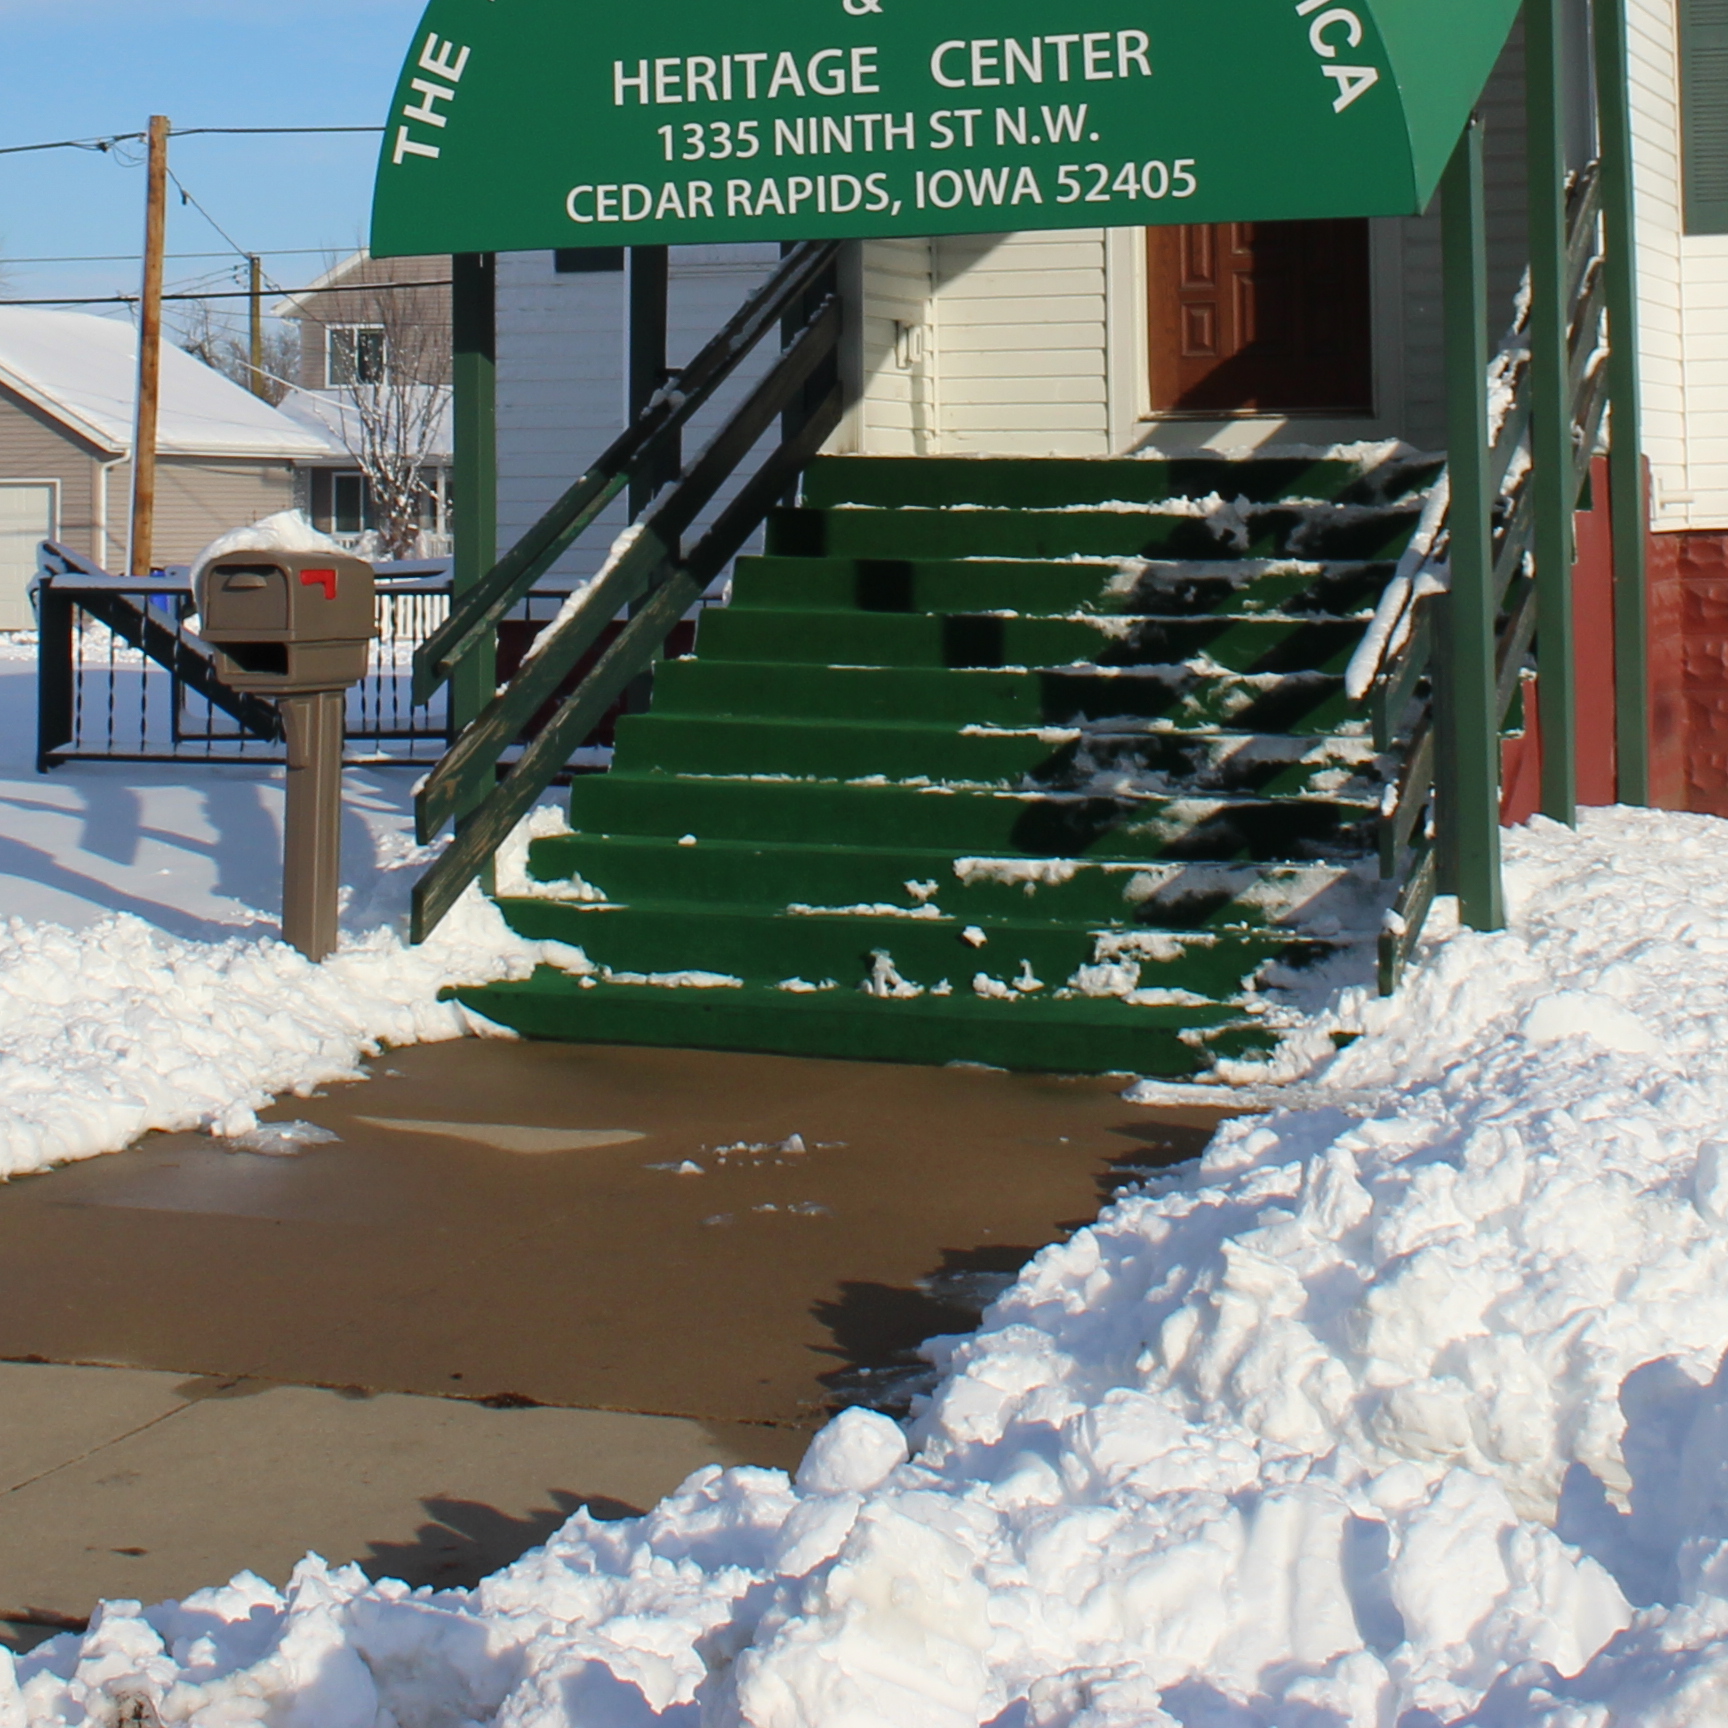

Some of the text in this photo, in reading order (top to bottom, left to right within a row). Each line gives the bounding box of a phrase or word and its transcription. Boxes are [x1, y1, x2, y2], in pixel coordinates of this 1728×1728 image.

[393, 33, 471, 166] THE
[613, 29, 1153, 106] HERITAGE CENTER
[657, 102, 1101, 162] 1335 NINTH ST N.W.
[565, 158, 1197, 223] CEDAR RAPIDS, IOWA 52405
